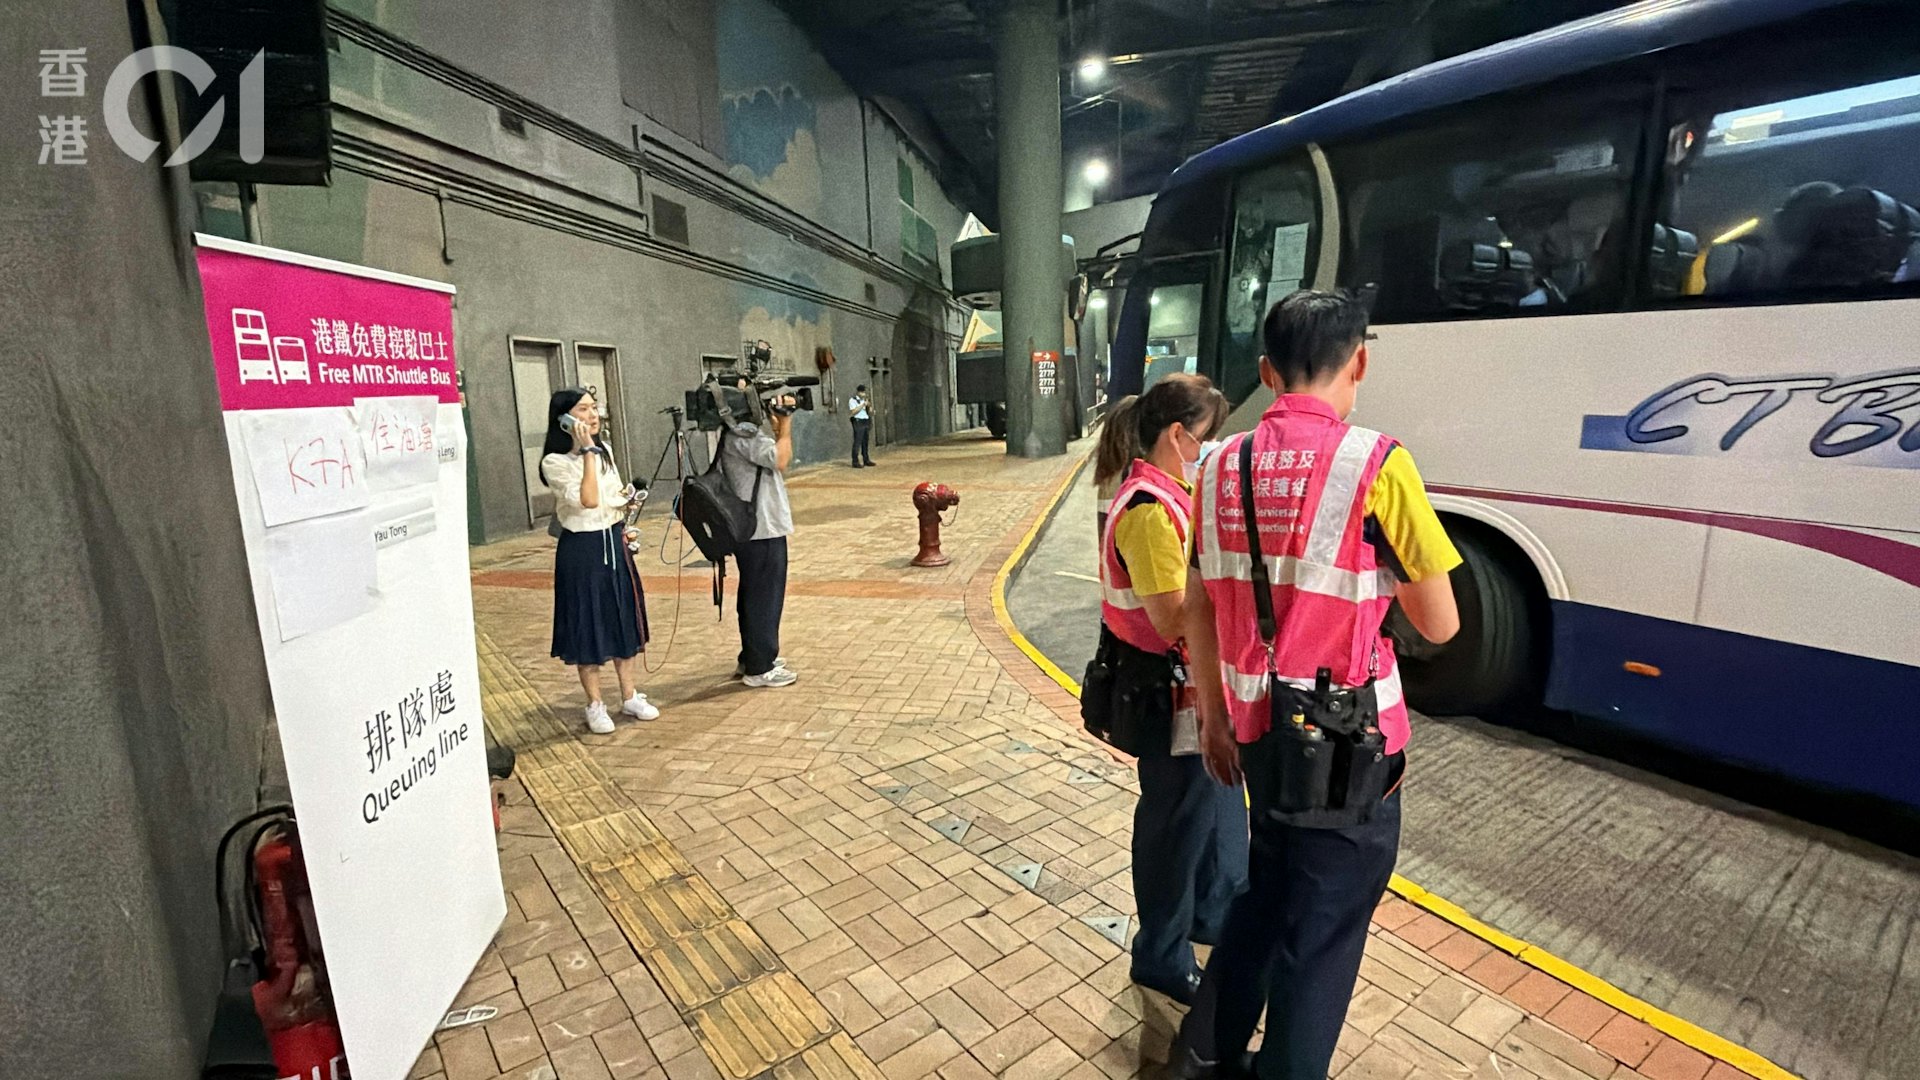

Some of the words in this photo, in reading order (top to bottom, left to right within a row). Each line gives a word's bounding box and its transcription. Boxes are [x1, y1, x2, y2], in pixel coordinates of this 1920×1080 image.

[310, 317, 449, 362] 港鐵免費接駁巴士
[318, 362, 350, 384] Free
[353, 365, 385, 384] MTR
[386, 367, 428, 385] Shuttle
[431, 368, 451, 385] Bus
[1038, 361, 1055, 369] 277A
[1038, 378, 1055, 386] 277X
[1038, 386, 1056, 395] T277
[1625, 370, 1920, 458] CTB
[1221, 477, 1309, 498] 收保護組
[374, 530, 388, 543] Yau
[389, 524, 408, 538] Tong
[363, 669, 457, 775] 排隊處
[362, 746, 437, 824] Queuing
[438, 723, 468, 758] line
